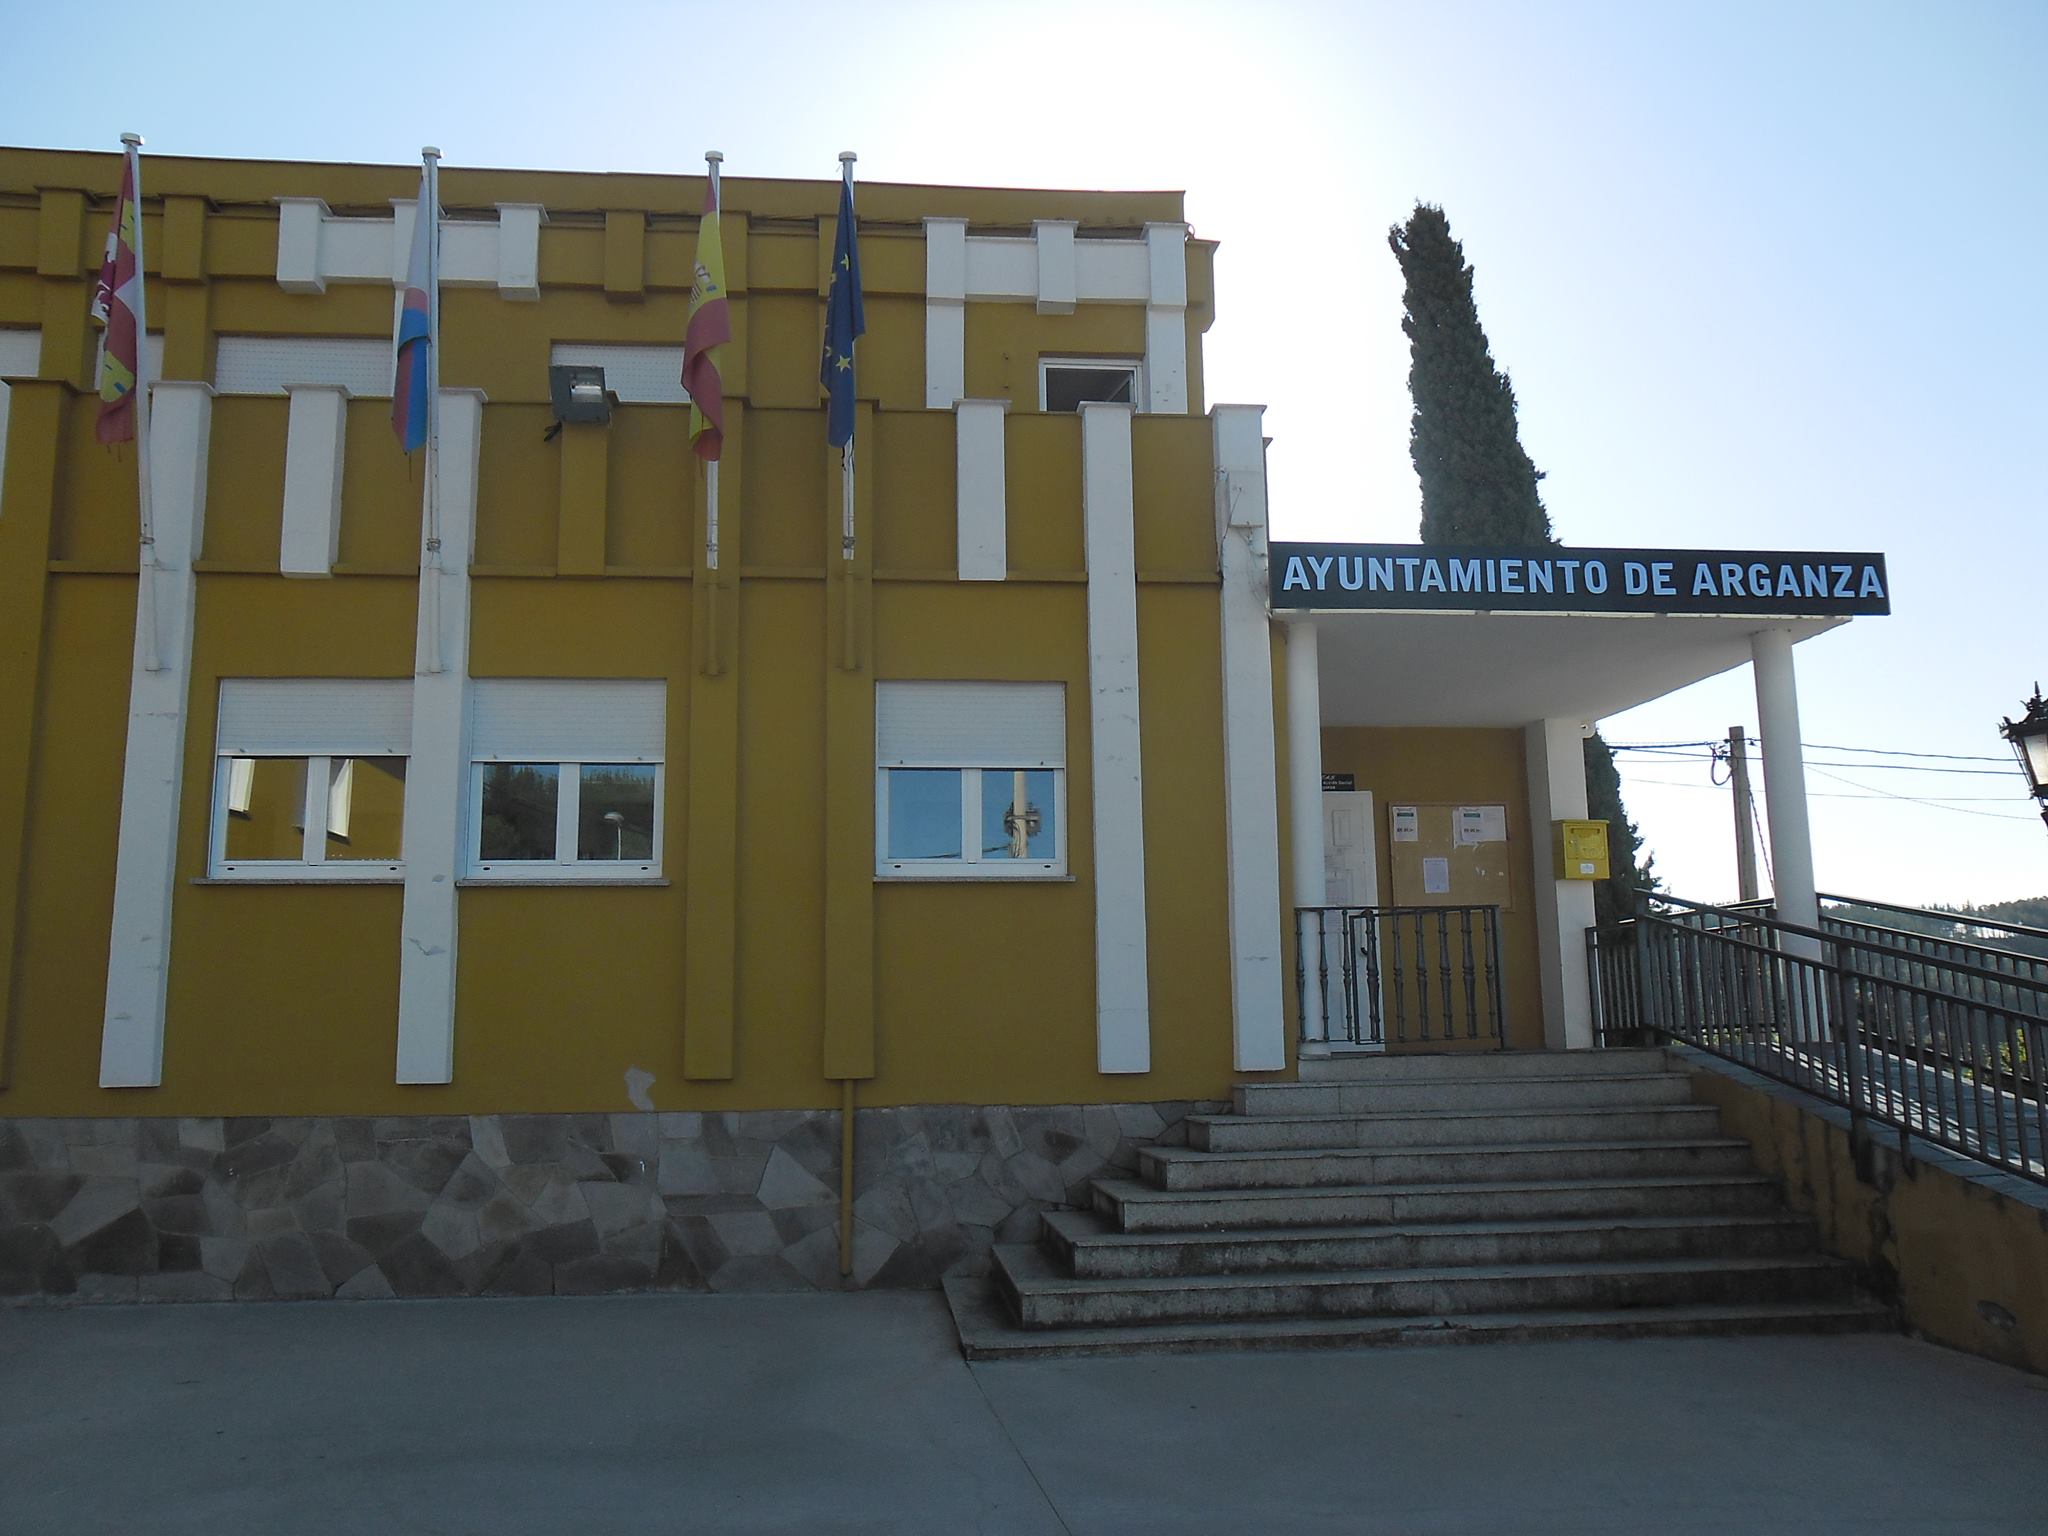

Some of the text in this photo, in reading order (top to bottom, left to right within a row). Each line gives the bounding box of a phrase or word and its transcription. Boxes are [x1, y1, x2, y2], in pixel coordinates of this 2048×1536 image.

[1282, 555, 1885, 599] AYUNTAMIENTO DE ARGANZA
